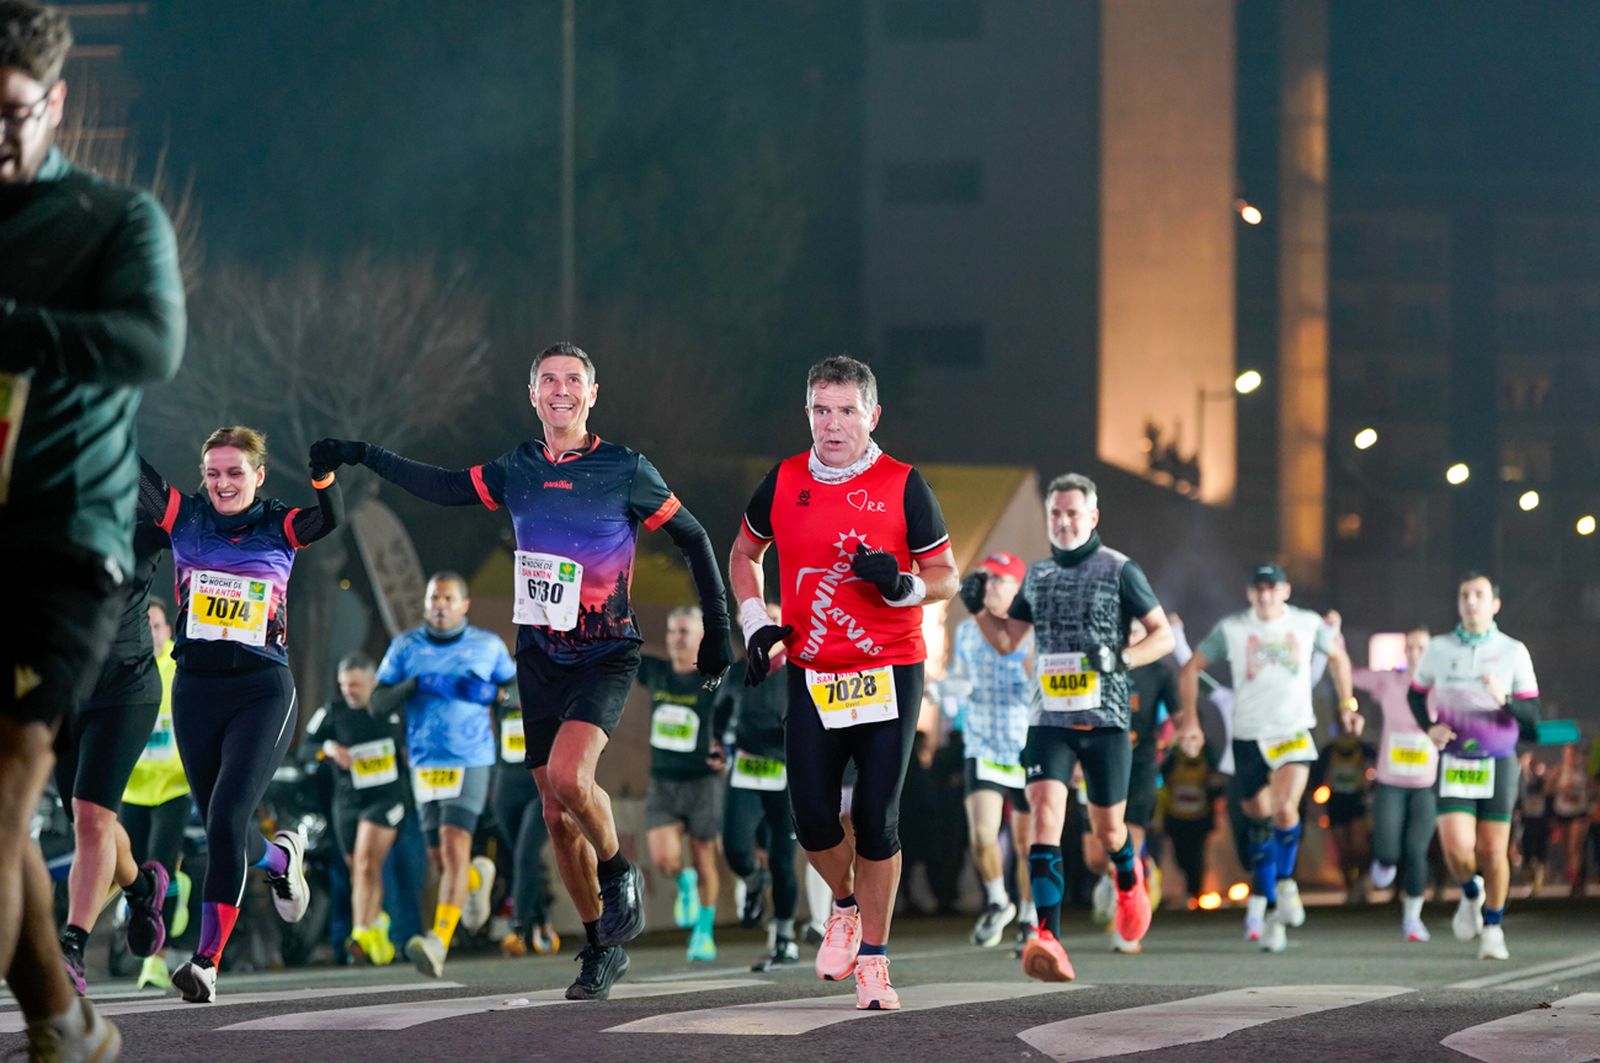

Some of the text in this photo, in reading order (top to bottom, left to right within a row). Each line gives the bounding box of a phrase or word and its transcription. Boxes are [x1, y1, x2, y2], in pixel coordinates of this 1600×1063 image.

[199, 586, 214, 595] SAN
[208, 579, 242, 589] NOCHE DE
[206, 596, 250, 621] 7074
[799, 561, 850, 661] RUNNING
[826, 607, 883, 657] RIVAS
[825, 675, 877, 704] 7028
[1050, 674, 1087, 690] 4404
